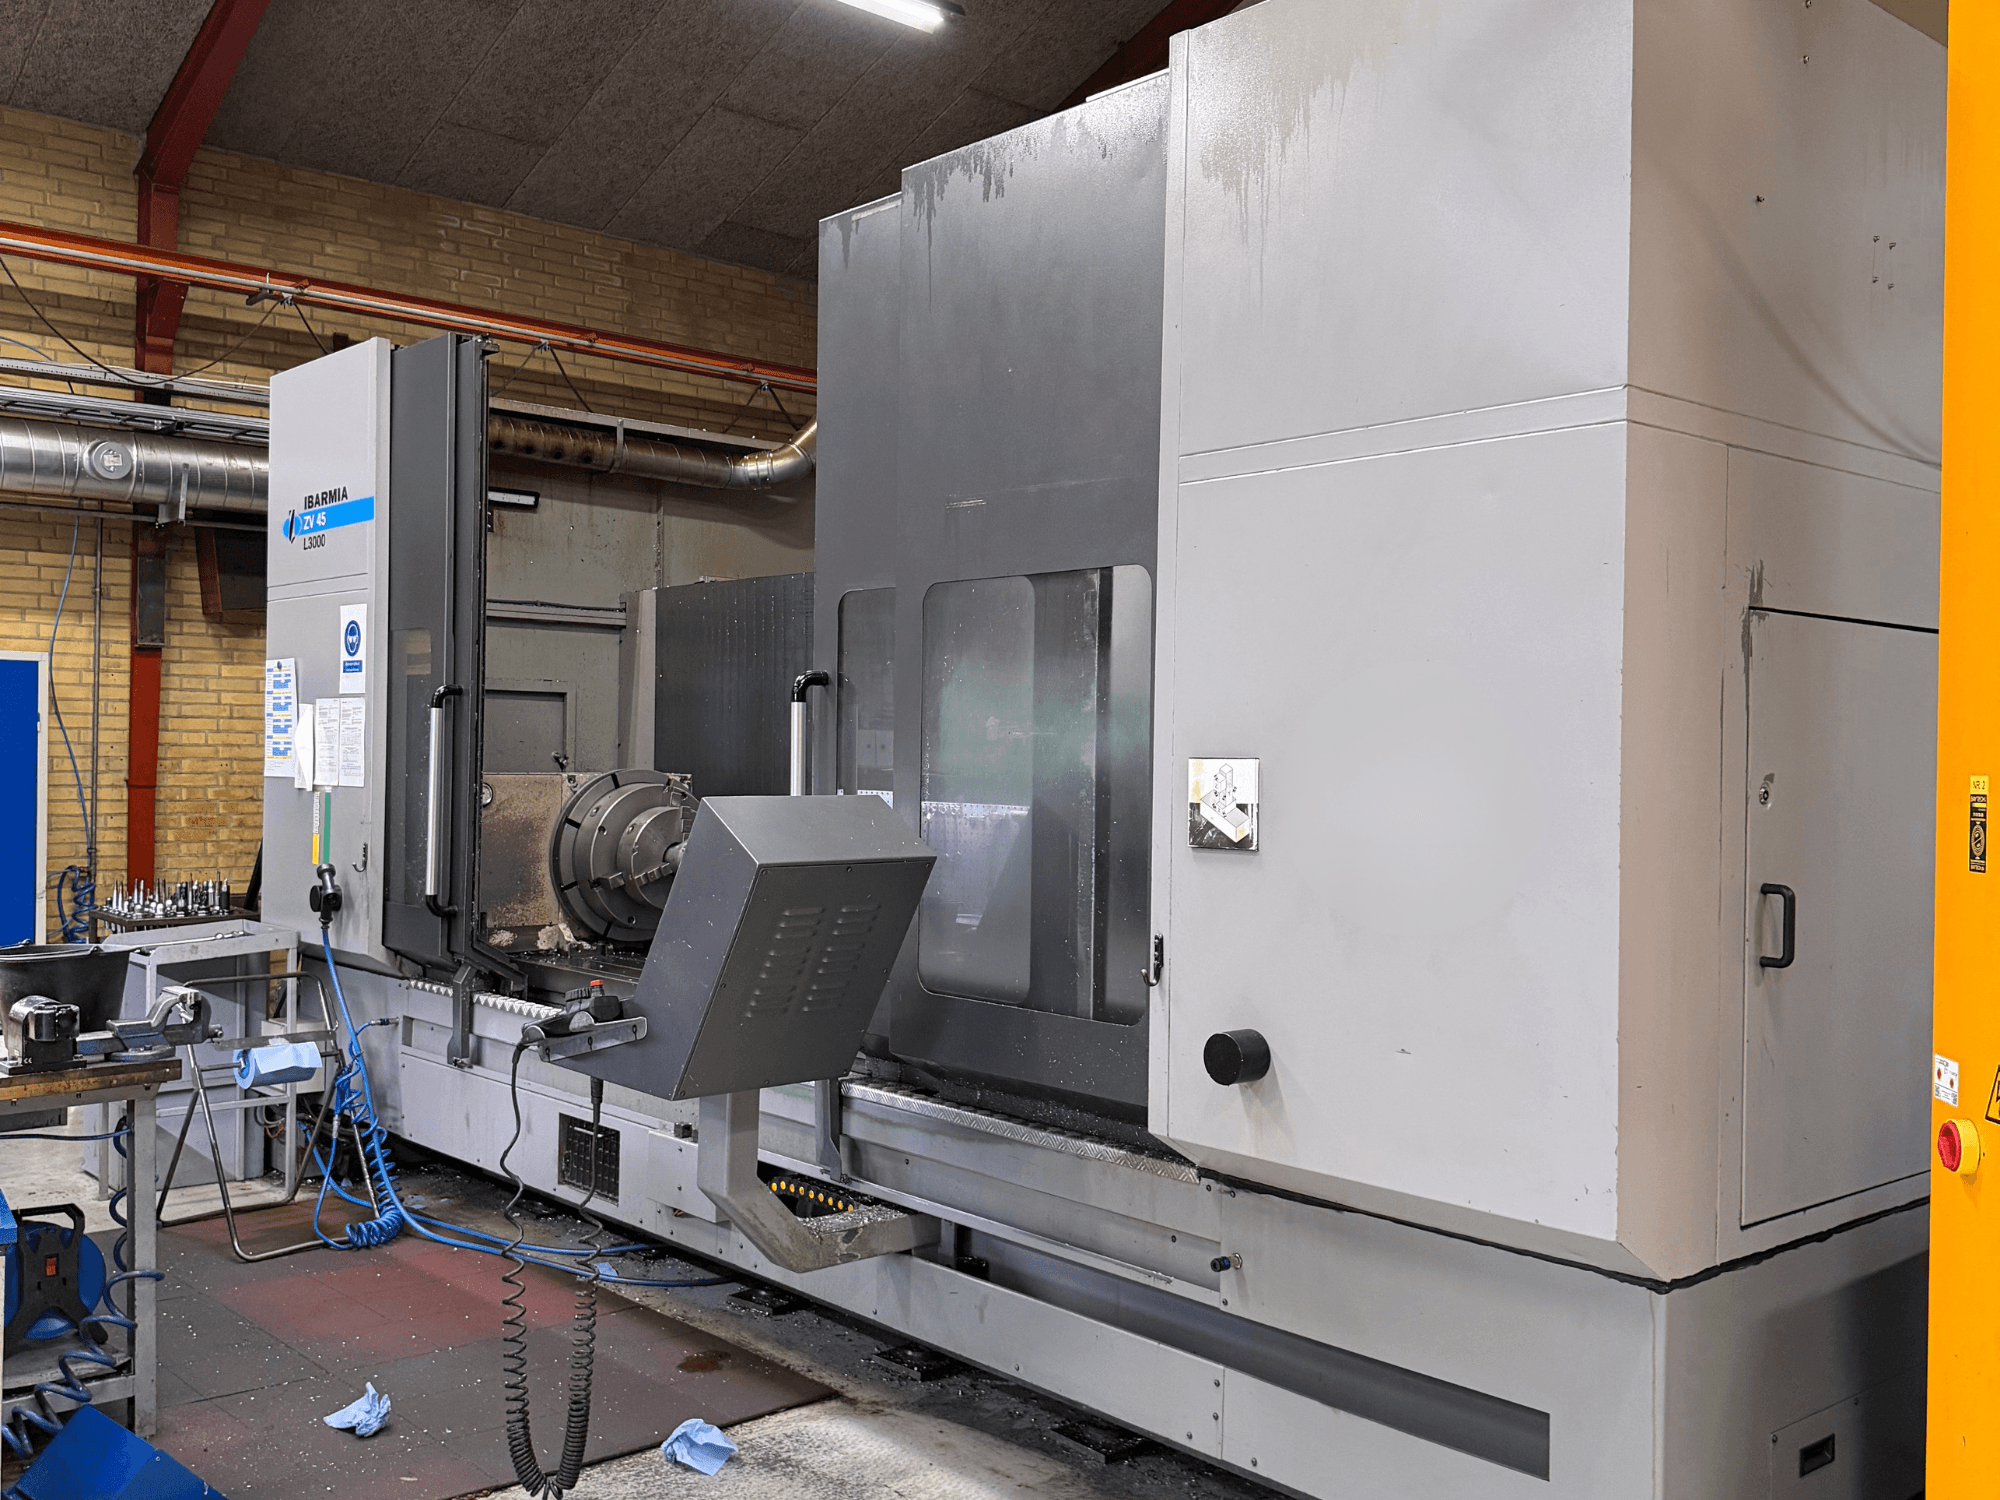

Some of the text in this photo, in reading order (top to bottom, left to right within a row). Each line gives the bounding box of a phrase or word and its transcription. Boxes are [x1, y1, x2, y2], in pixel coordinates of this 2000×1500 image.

[304, 486, 348, 509] IBARMIA
[303, 511, 327, 530] ZV 45
[303, 534, 326, 551] L3000
